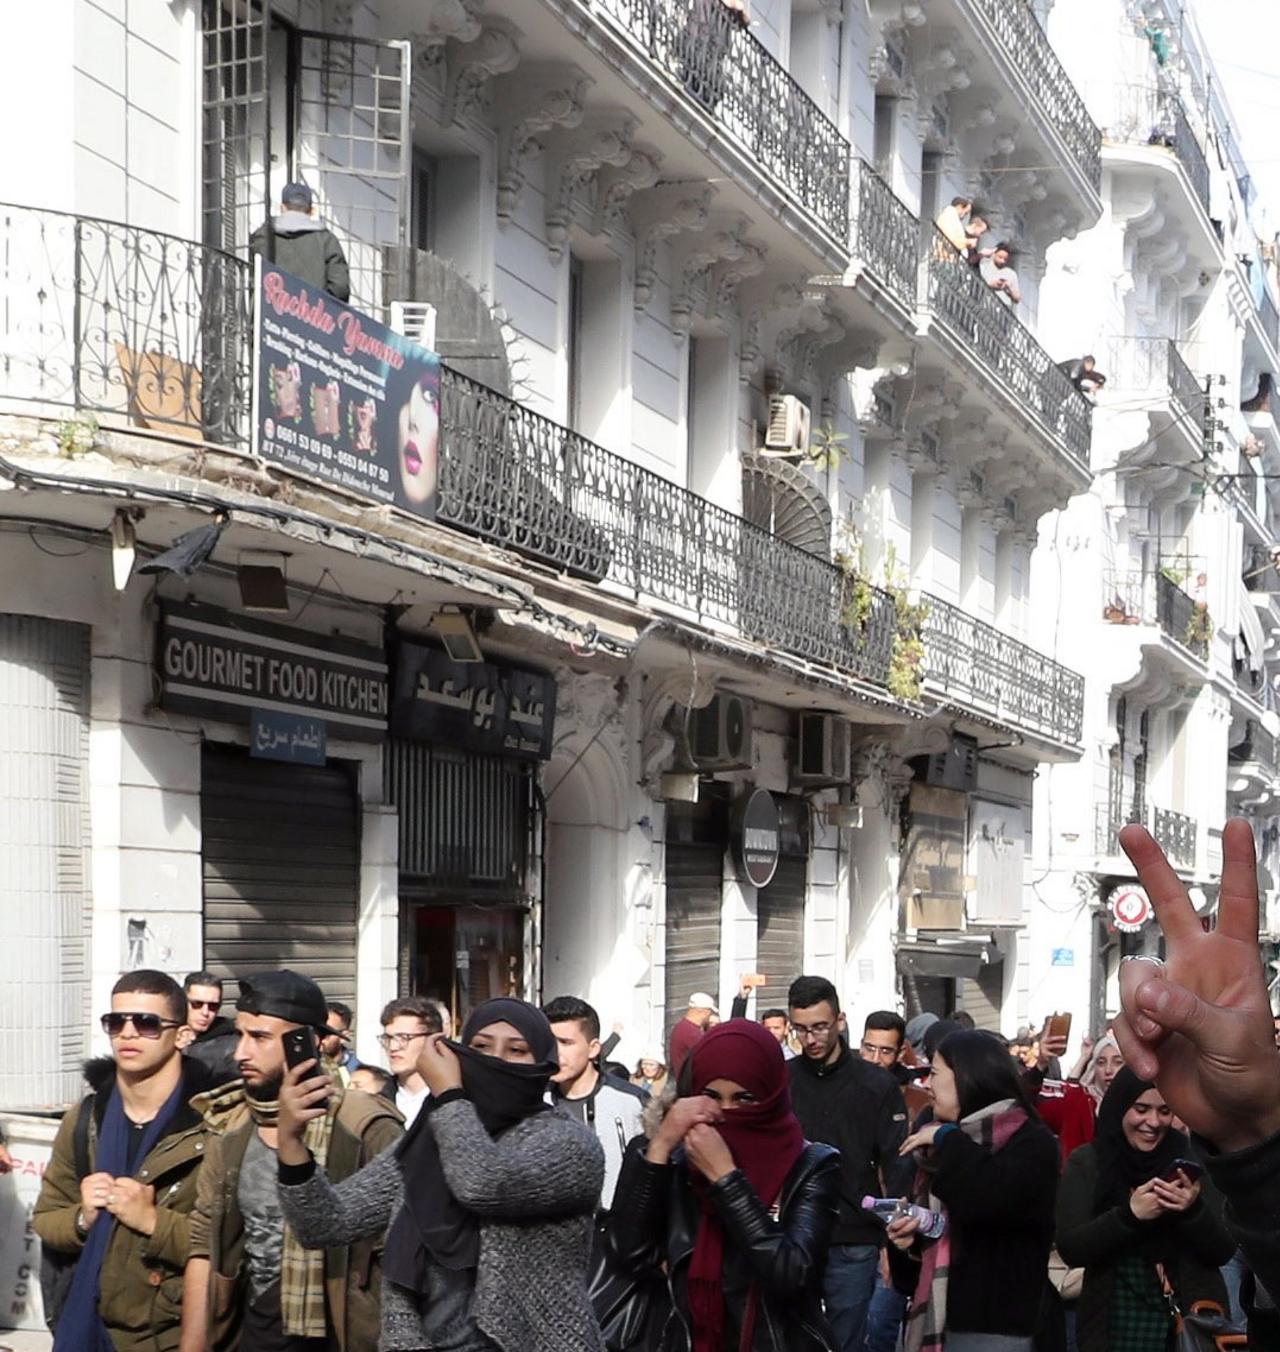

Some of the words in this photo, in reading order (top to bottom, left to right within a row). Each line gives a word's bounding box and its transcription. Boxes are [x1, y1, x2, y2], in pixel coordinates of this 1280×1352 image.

[165, 637, 264, 692] GOURMET
[269, 659, 318, 702] FOOD
[321, 670, 389, 715] KITCHEN
